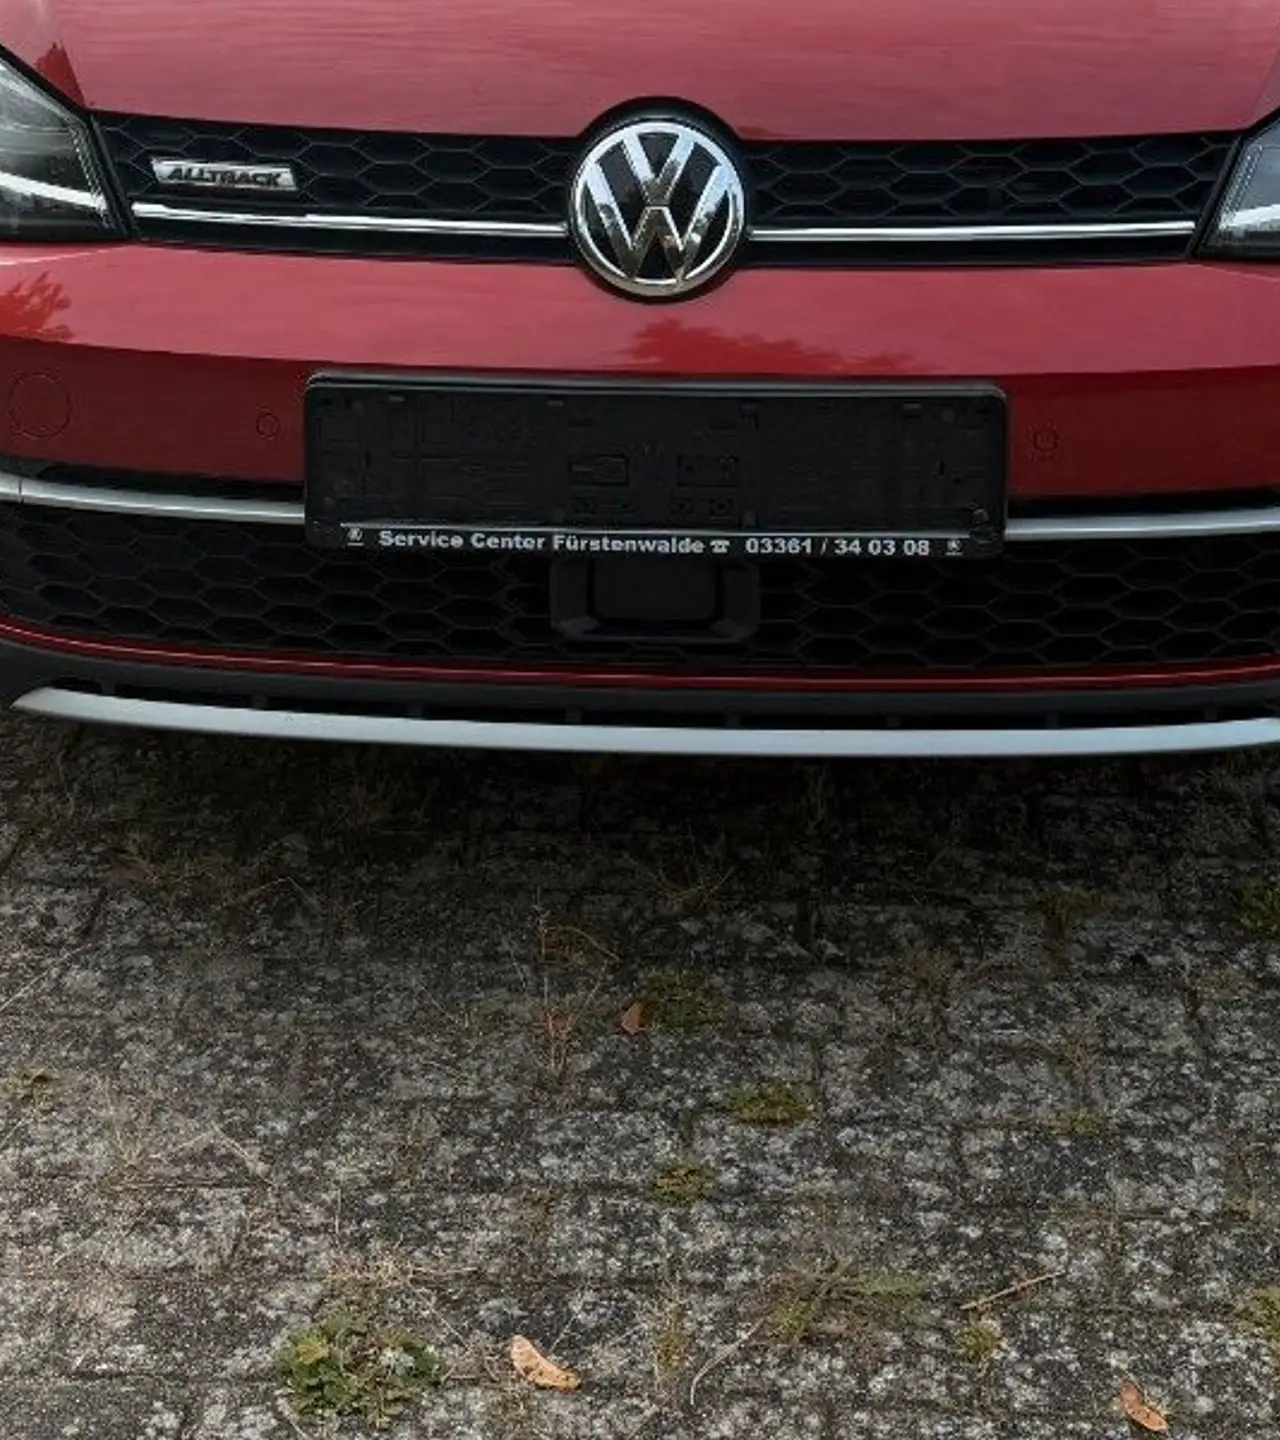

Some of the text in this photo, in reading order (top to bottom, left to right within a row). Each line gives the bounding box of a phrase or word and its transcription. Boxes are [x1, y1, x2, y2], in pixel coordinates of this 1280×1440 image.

[168, 166, 282, 187] ALLTRACK
[378, 529, 464, 549] Service
[470, 532, 546, 551] Center
[552, 533, 705, 554] Fürstenwalde
[744, 537, 813, 555] 03361
[834, 538, 862, 555] 34
[868, 539, 896, 556] 03
[903, 540, 931, 557] 08
